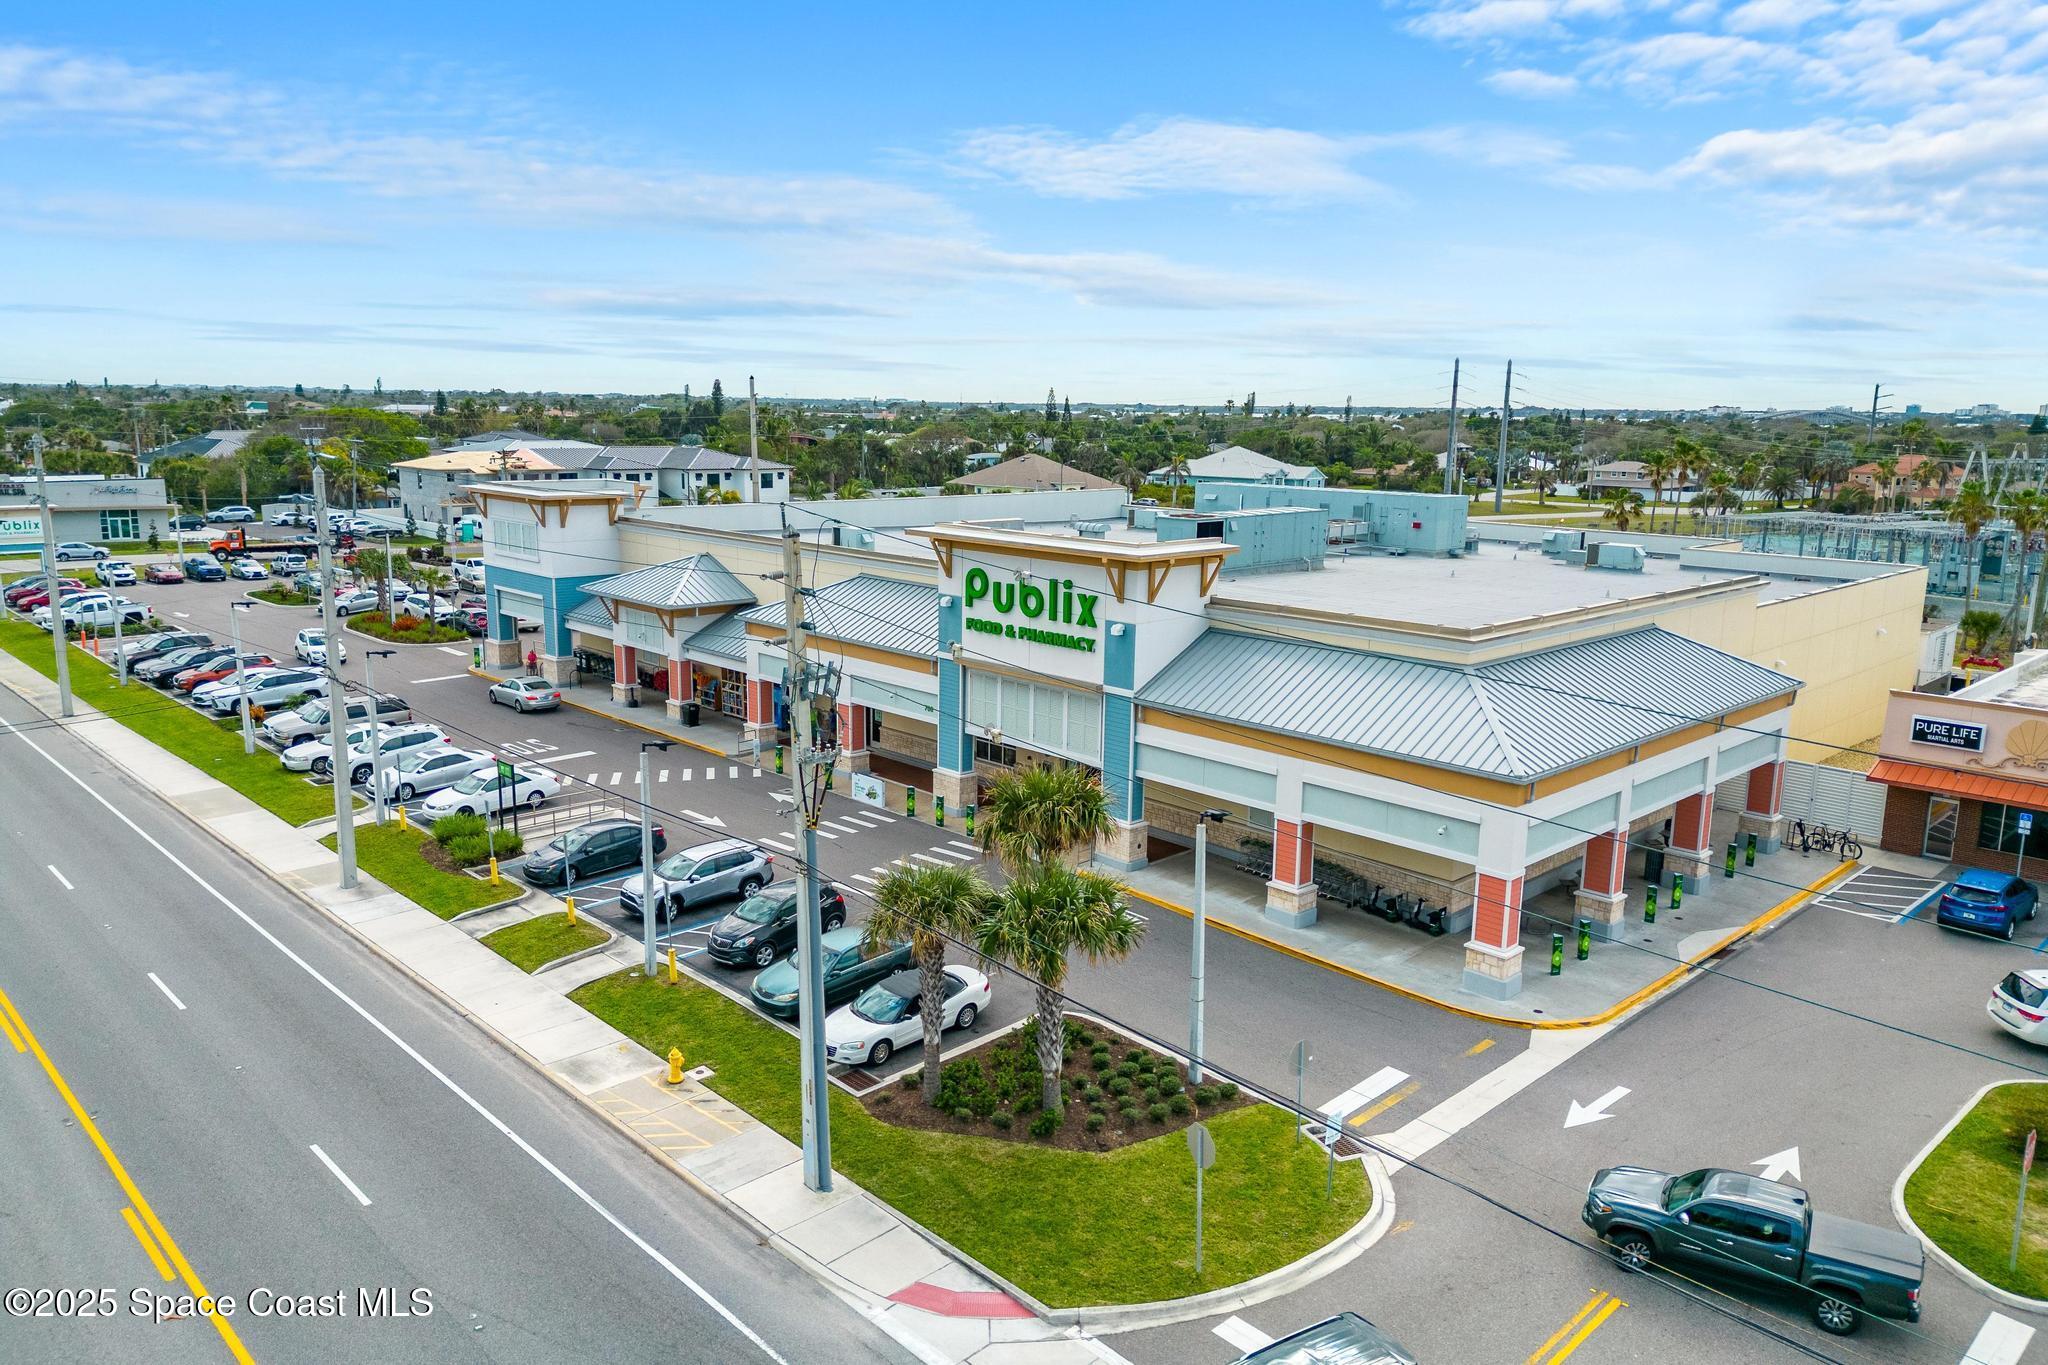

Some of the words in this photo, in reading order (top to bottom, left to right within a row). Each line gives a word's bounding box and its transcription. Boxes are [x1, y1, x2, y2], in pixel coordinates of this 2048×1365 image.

[12, 488, 27, 496] SPA
[0, 520, 40, 531] ublix
[965, 567, 1098, 628] Publix
[965, 617, 1003, 635] FOOD
[1005, 624, 1016, 638] &
[1018, 626, 1096, 652] PHARMACY
[1916, 721, 1950, 735] PURE
[1952, 726, 1979, 740] LIFE
[1927, 734, 1949, 743] MARTIAL
